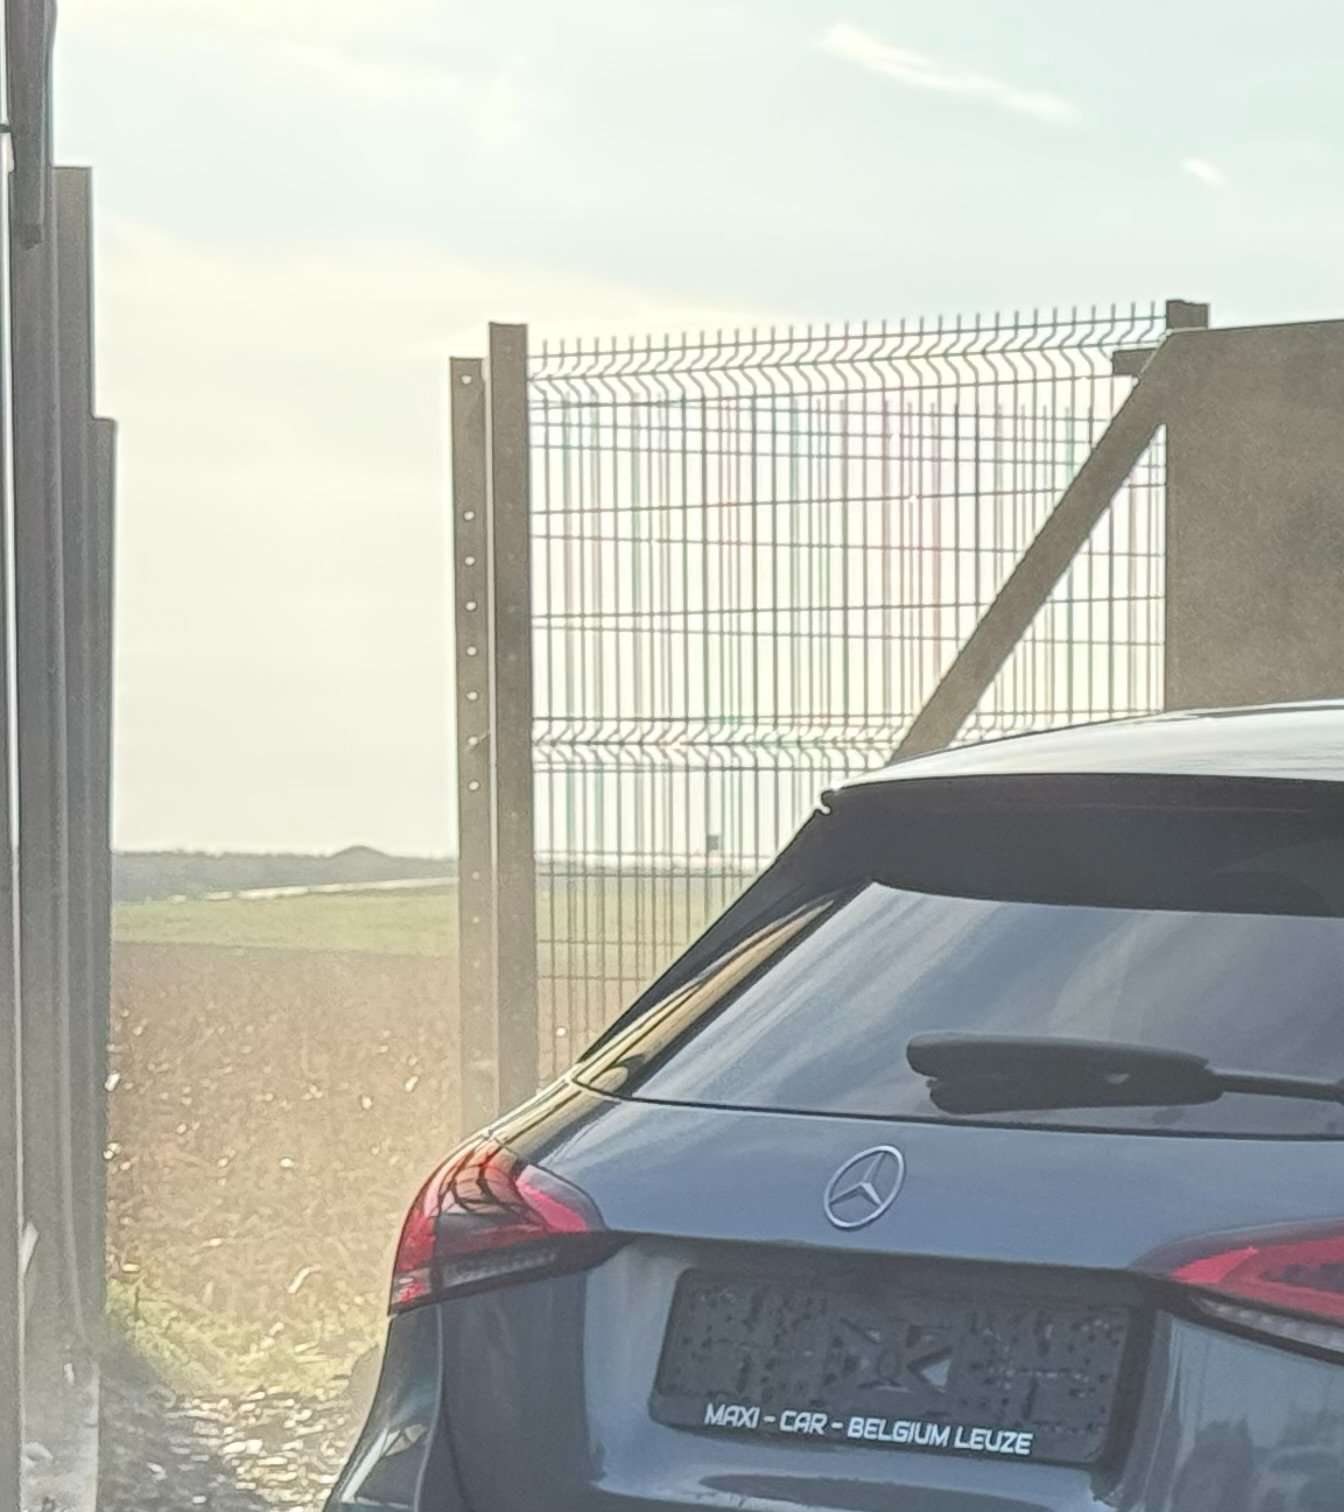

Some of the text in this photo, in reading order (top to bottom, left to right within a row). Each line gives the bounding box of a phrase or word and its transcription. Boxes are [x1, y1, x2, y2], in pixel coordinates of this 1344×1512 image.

[704, 1403, 760, 1429] MAXI
[779, 1410, 828, 1435] CAR
[848, 1416, 950, 1447] BELGIUM
[954, 1426, 1033, 1455] LEUZE
